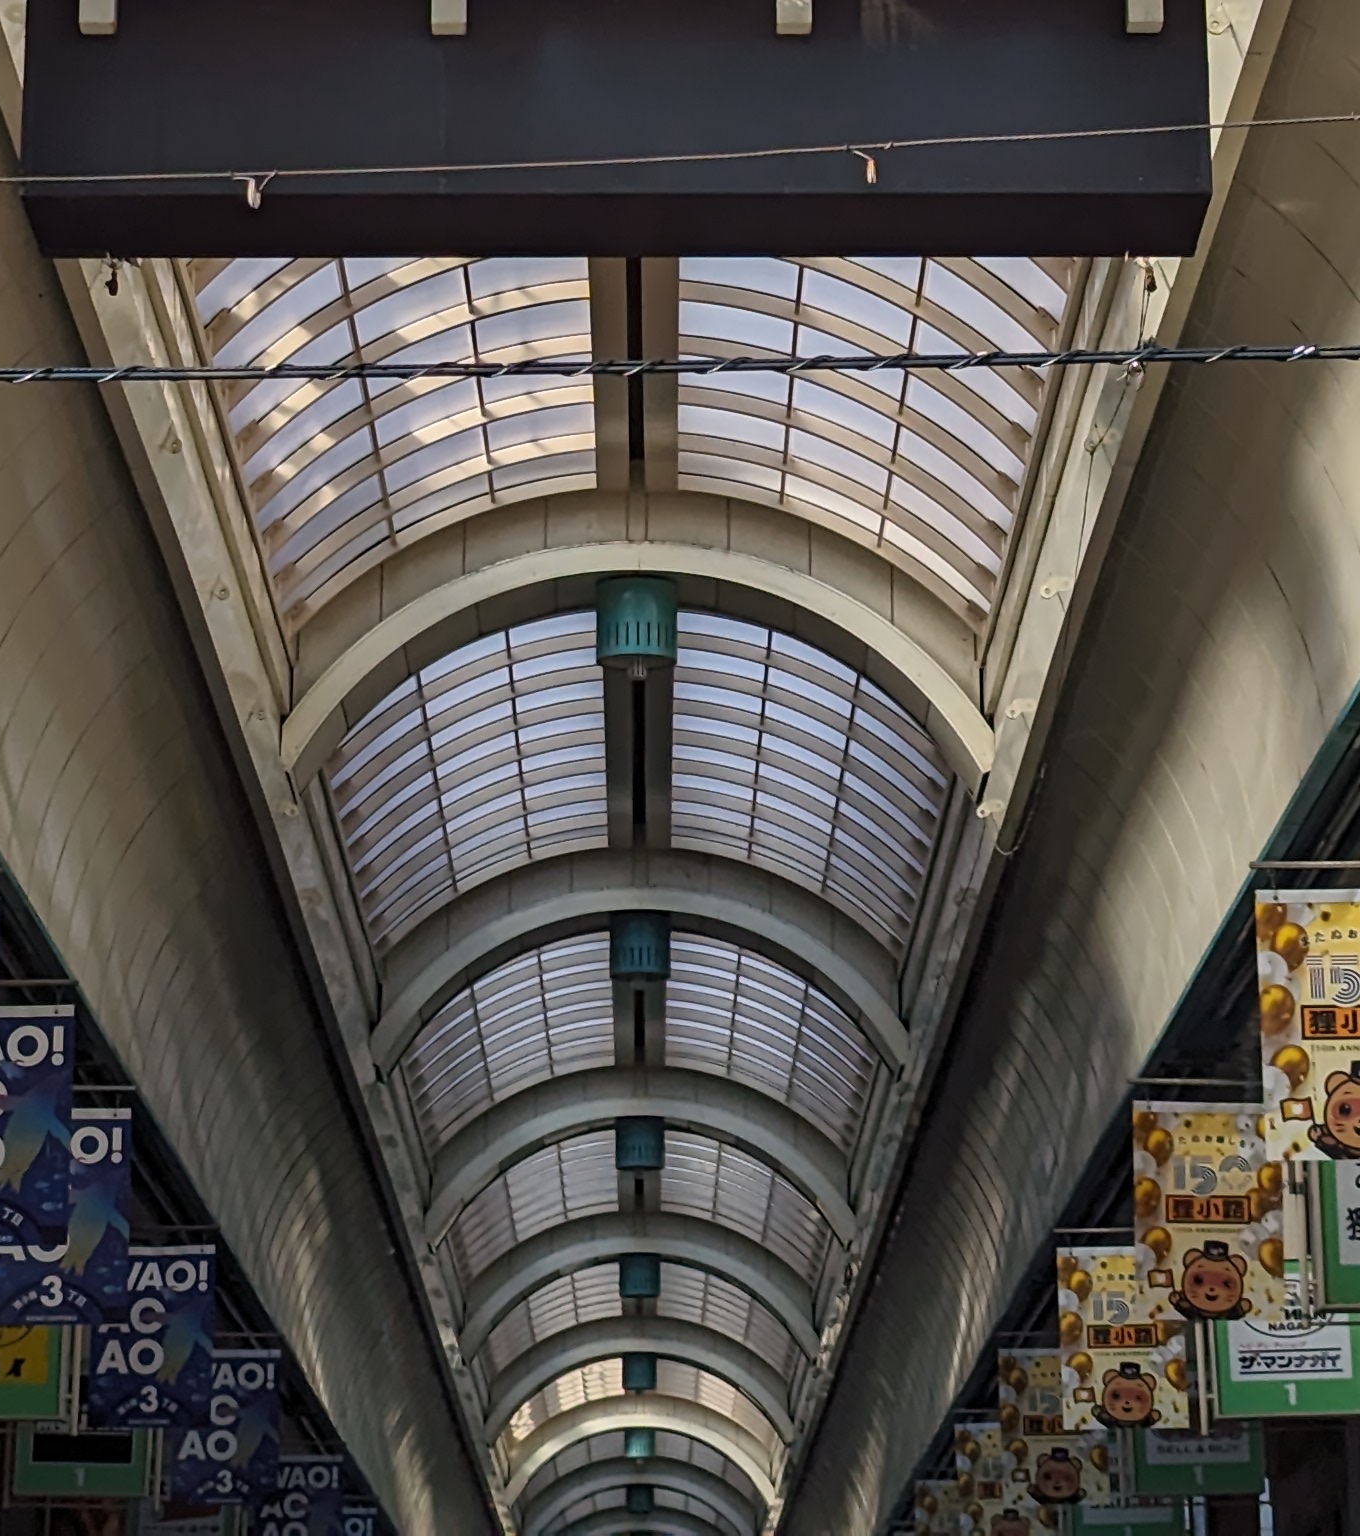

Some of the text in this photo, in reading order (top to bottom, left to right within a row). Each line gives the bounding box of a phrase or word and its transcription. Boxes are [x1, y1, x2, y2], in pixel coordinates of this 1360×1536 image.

[97, 1339, 164, 1375] AO
[1283, 1384, 1297, 1406] 1
[178, 1430, 238, 1461] AO
